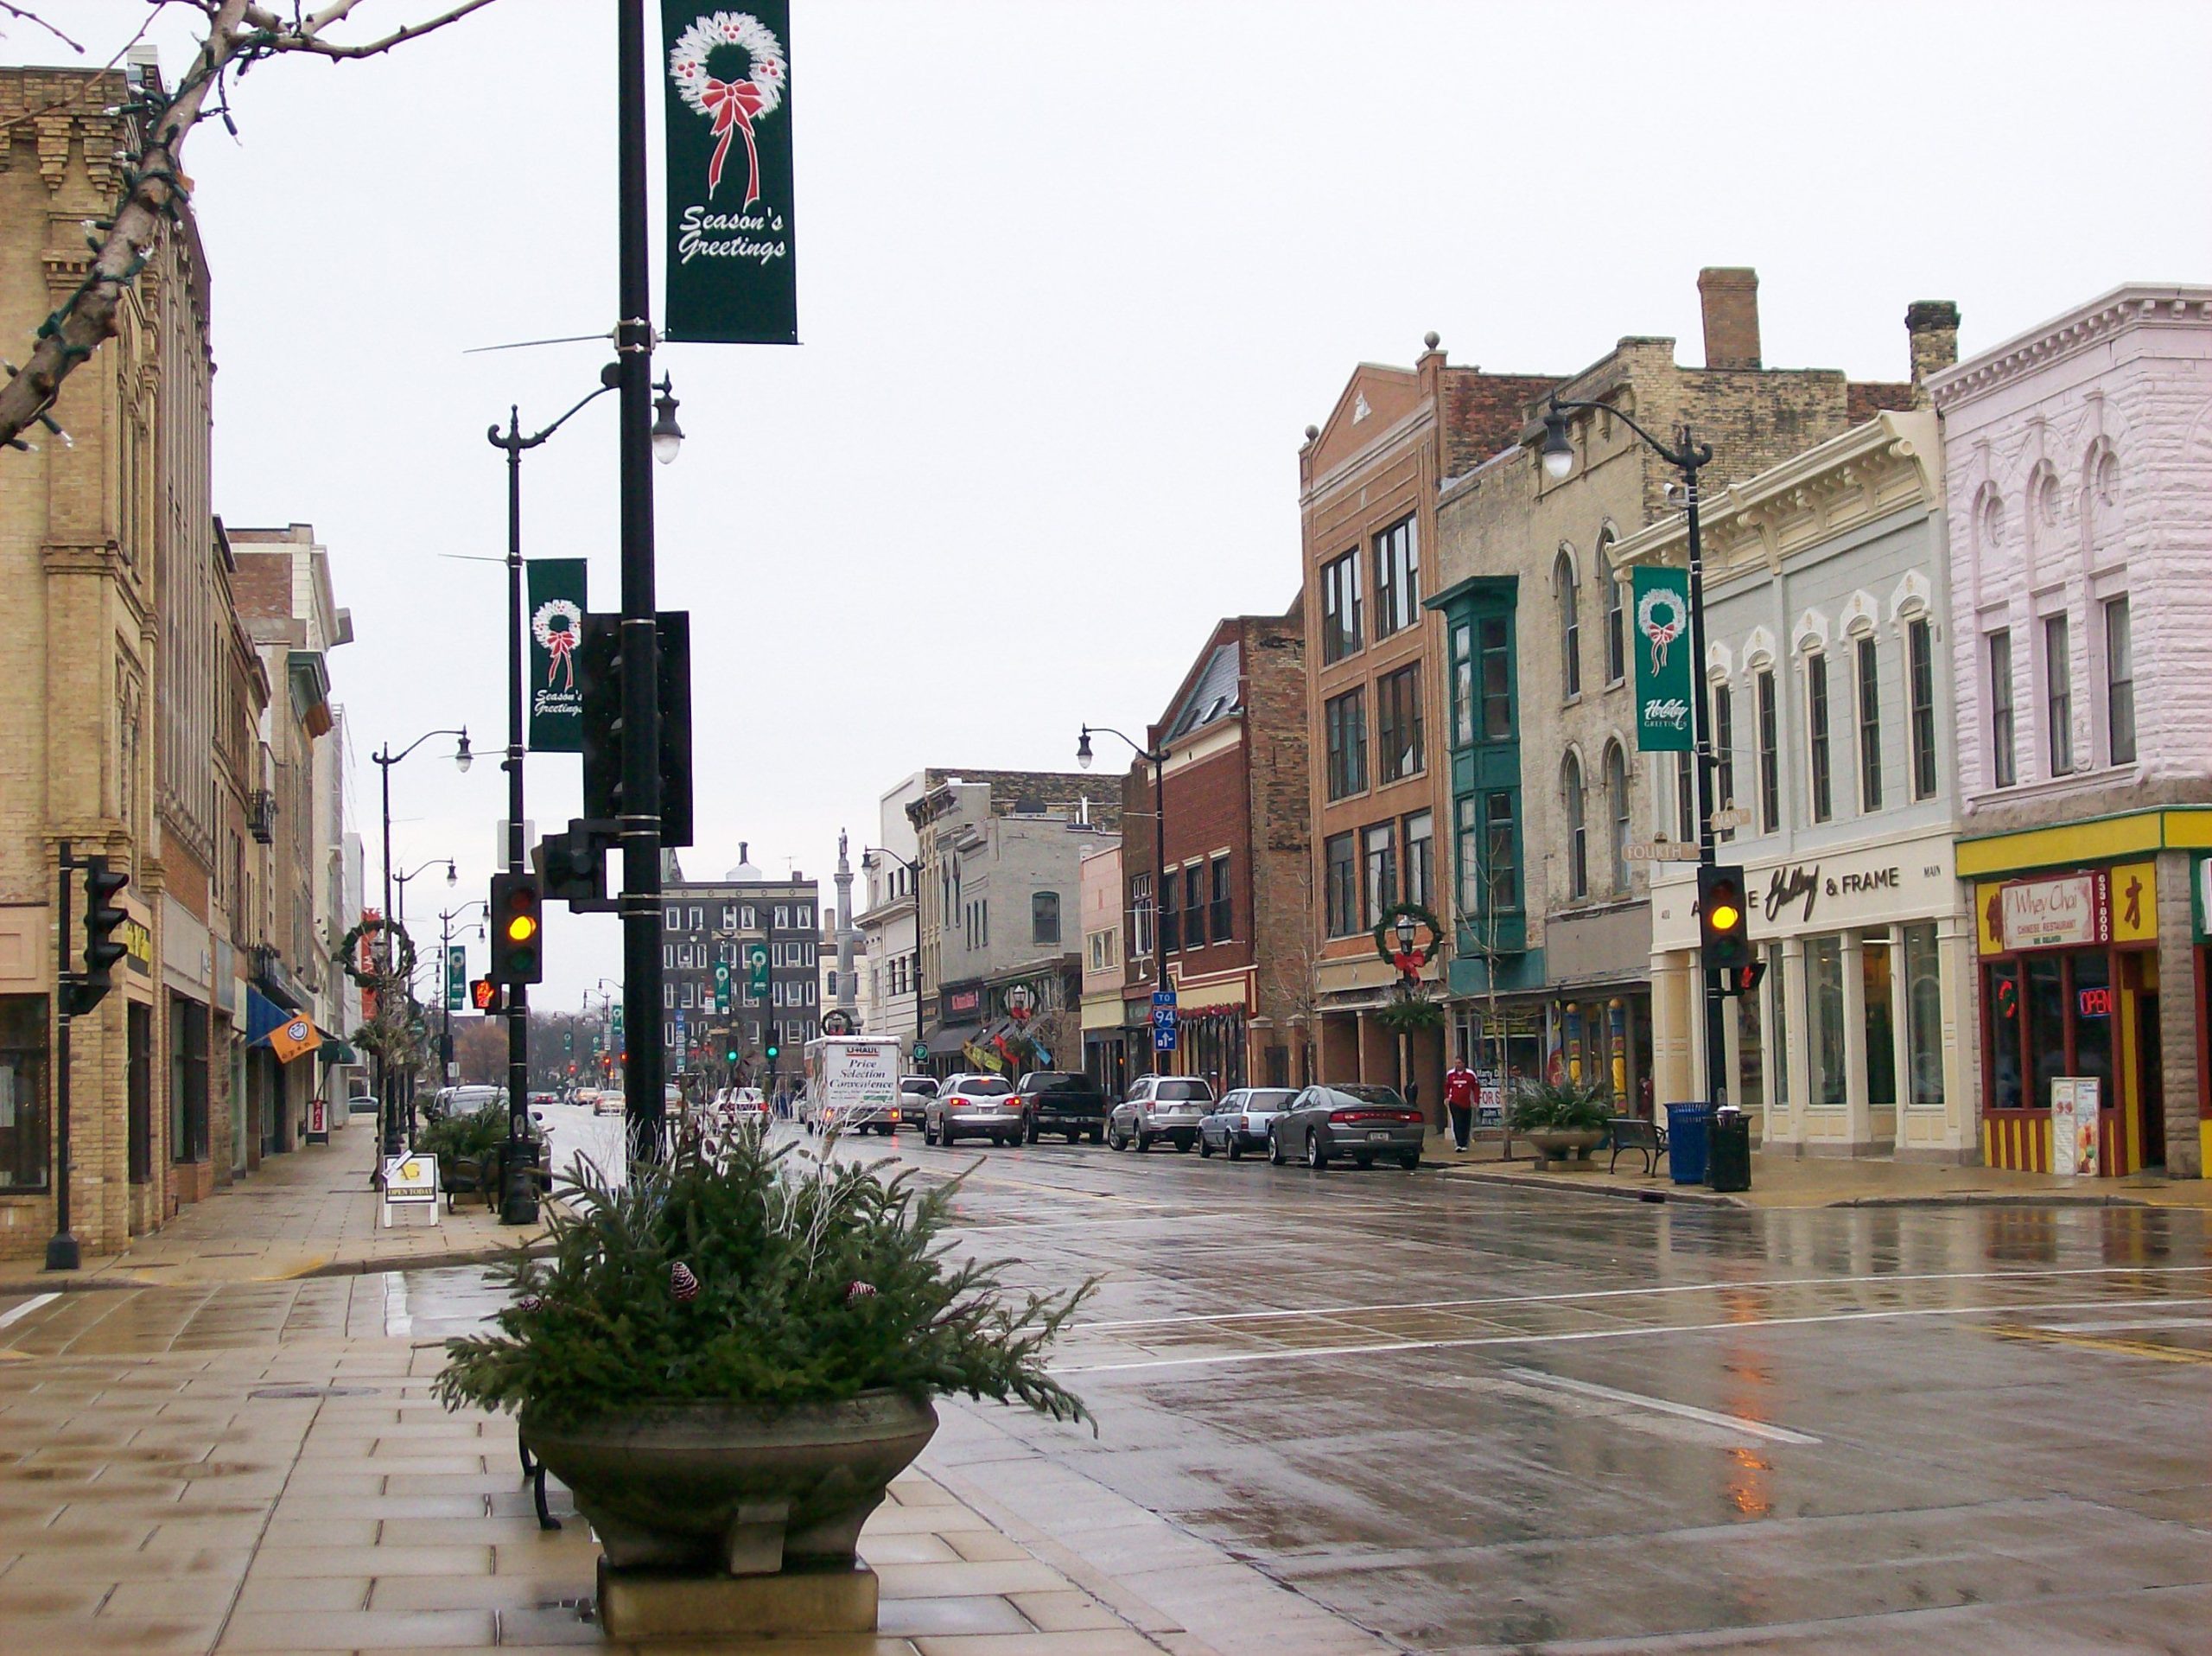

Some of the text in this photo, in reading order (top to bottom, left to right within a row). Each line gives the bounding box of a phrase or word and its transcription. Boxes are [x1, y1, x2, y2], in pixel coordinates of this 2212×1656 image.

[679, 206, 784, 231] Season's
[678, 230, 785, 264] Greetings
[535, 689, 582, 701] Season's
[1644, 698, 1688, 729] Holiday
[1715, 812, 1741, 827] MAIN
[1628, 844, 1681, 859] FOURTH
[1923, 864, 1942, 878] MAIN
[1826, 877, 1838, 896] &
[1841, 867, 1899, 894] FRAME
[2098, 874, 2108, 941] 633-8000
[2081, 989, 2112, 1015] OPEN
[1155, 1010, 1174, 1024] 94
[849, 1059, 877, 1068] Price
[840, 1069, 886, 1079] Selection
[830, 1080, 893, 1088] Convenience
